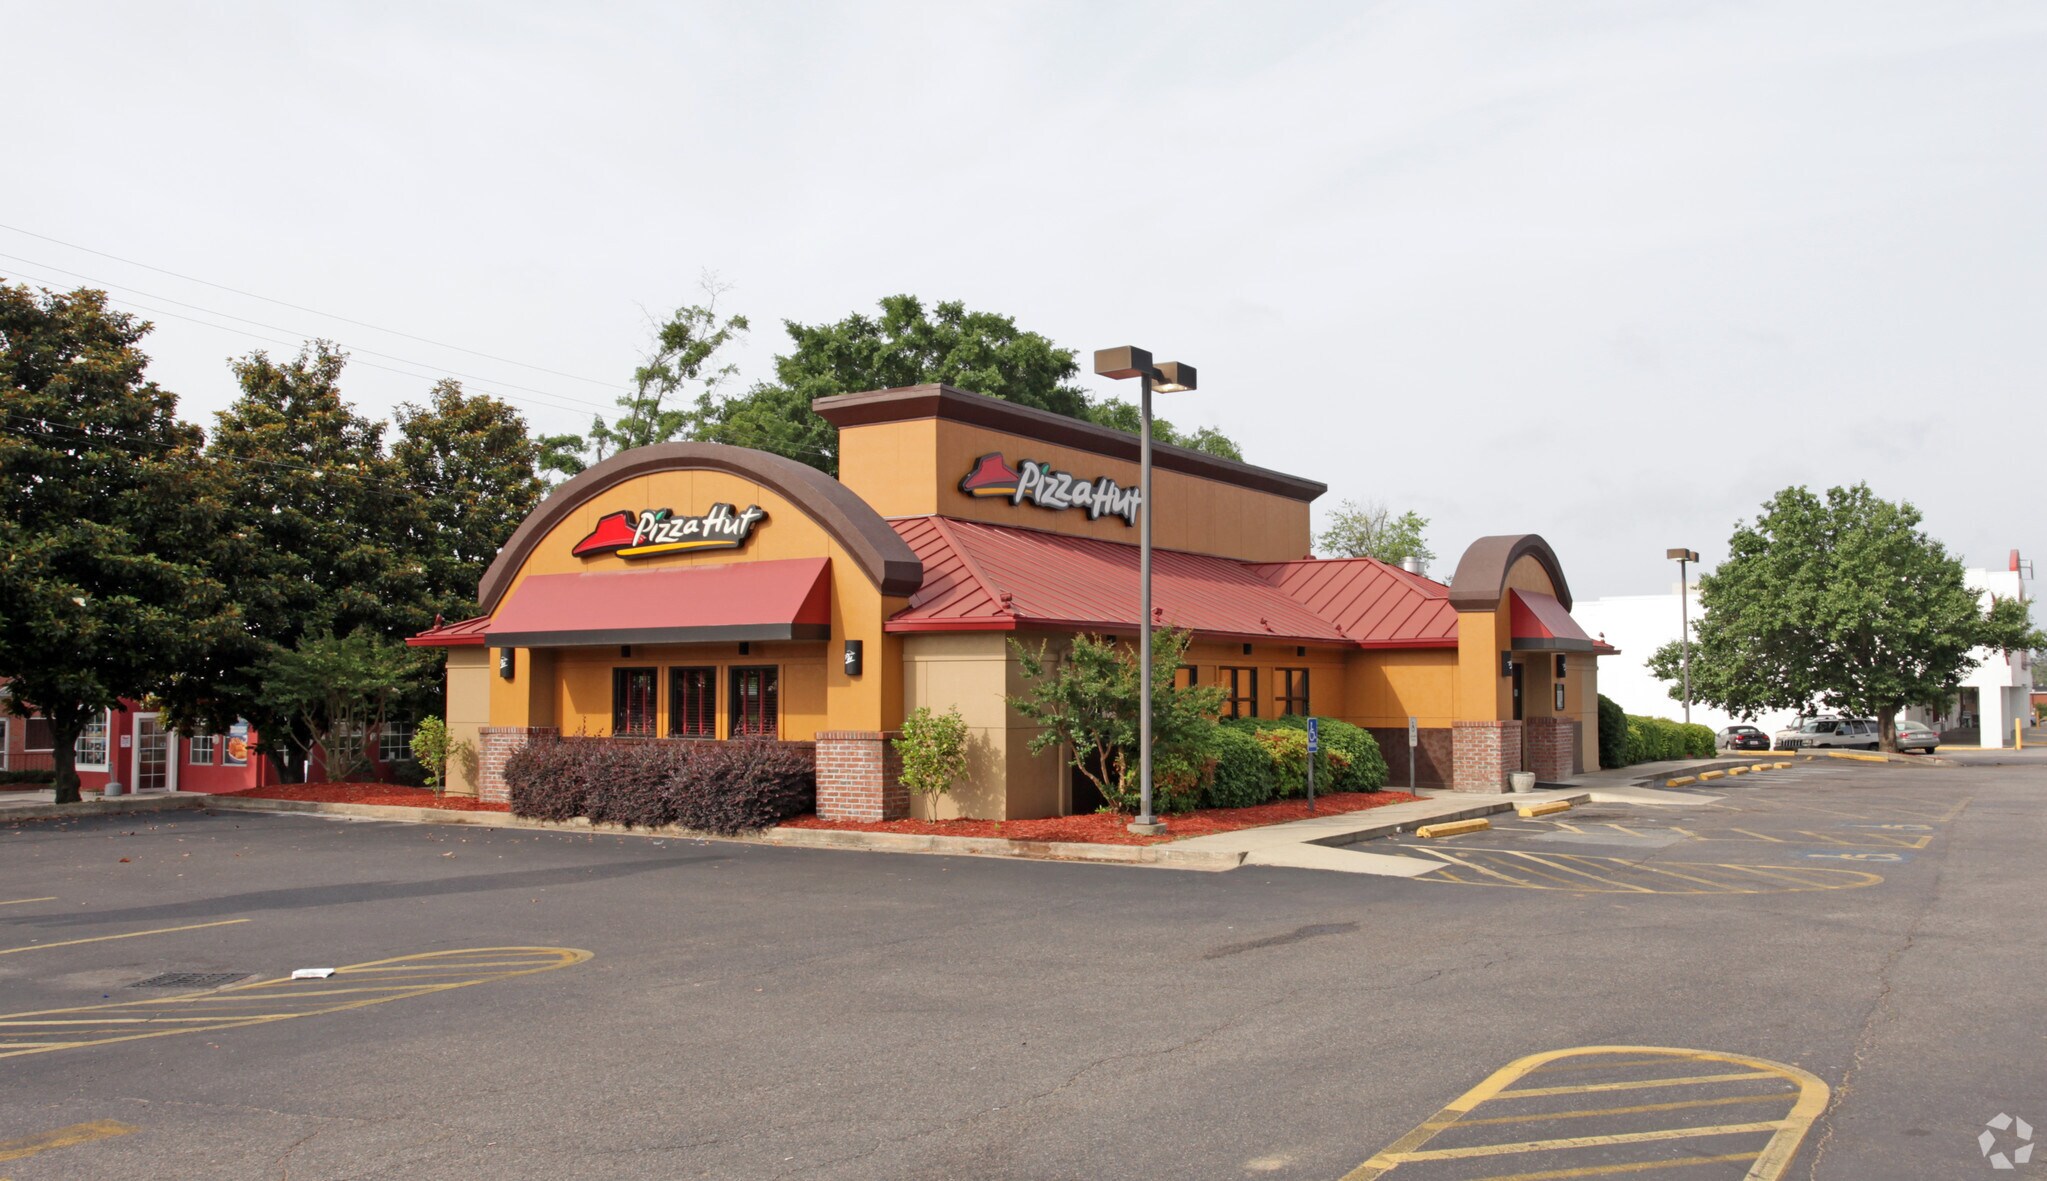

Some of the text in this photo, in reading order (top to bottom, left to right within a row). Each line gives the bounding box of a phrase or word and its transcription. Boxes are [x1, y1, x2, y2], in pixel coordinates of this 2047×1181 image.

[1015, 461, 1141, 525] Pizza Hut
[632, 505, 761, 547] Pizza Hut
